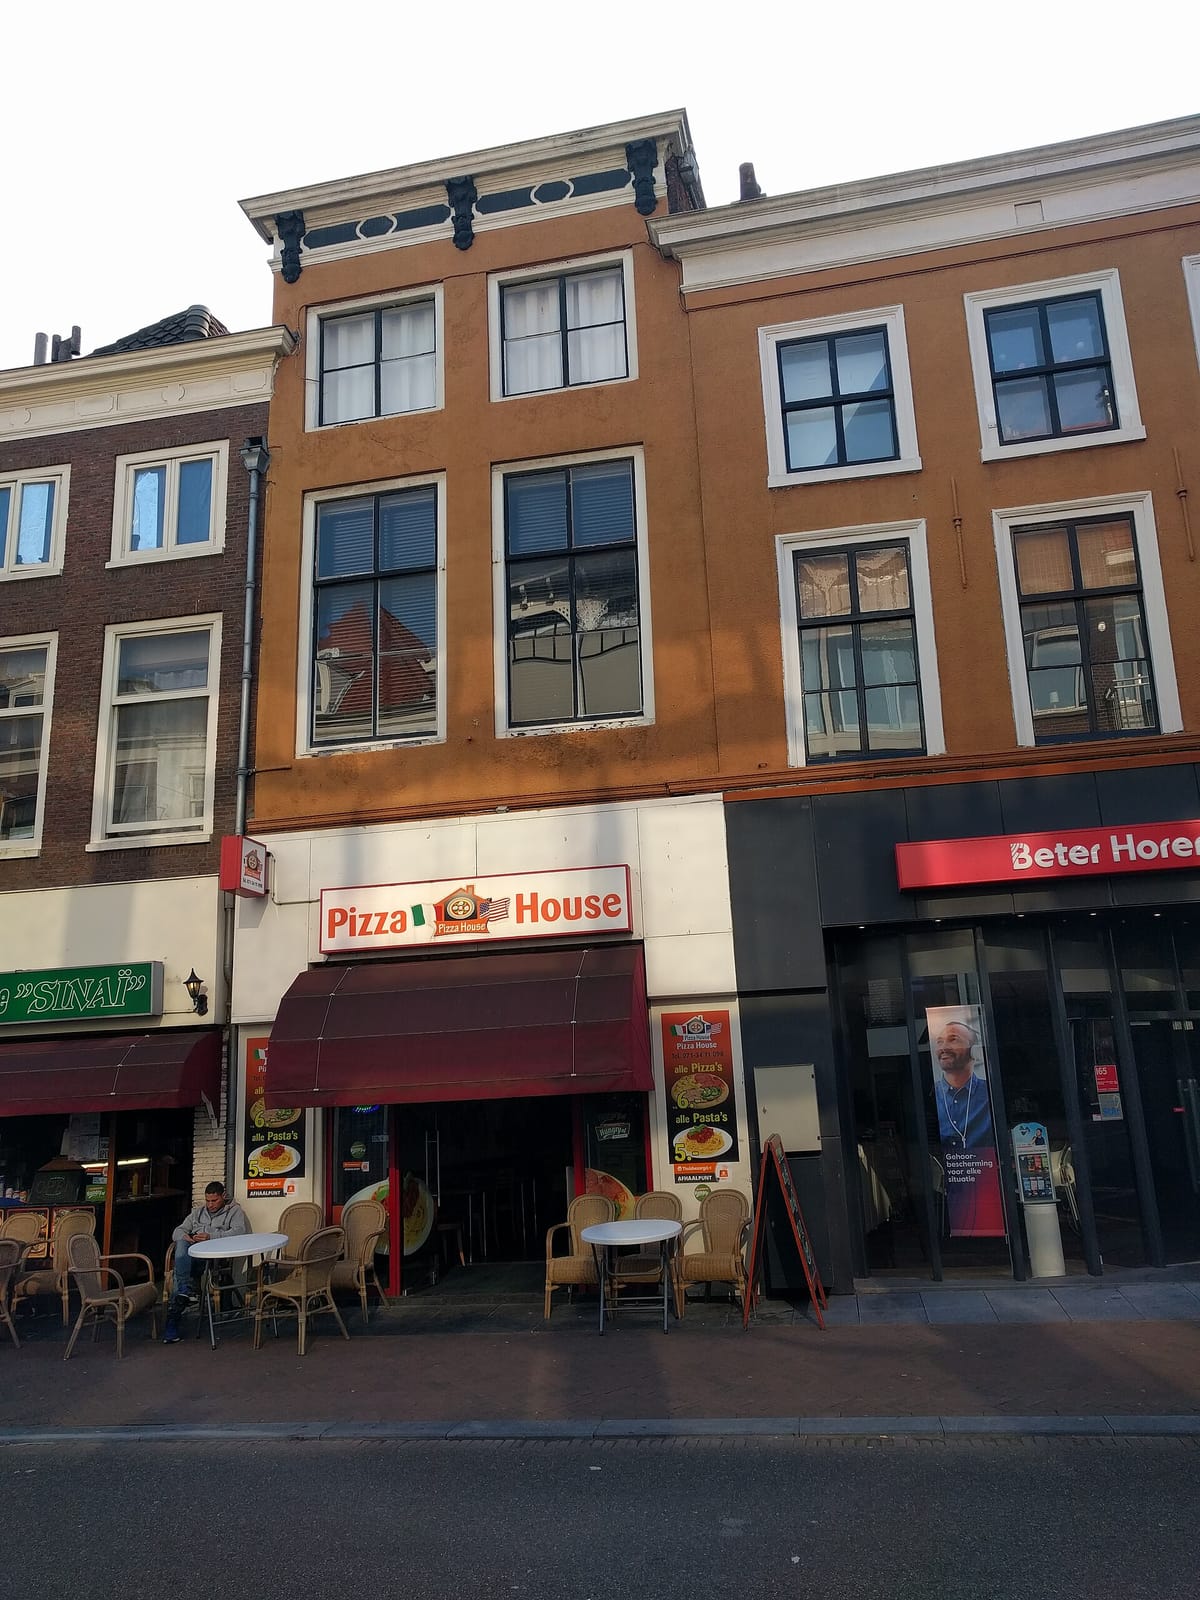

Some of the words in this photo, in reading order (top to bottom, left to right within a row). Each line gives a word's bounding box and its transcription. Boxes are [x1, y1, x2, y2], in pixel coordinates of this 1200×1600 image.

[1010, 842, 1100, 870] Beter
[327, 906, 407, 939] Pizza
[515, 892, 622, 924] House
[438, 922, 459, 933] Pizza
[460, 922, 486, 932] House
[676, 1042, 695, 1050] Pizza
[695, 1041, 718, 1049] House
[674, 1065, 689, 1074] alle
[691, 1062, 723, 1073] Pizza's
[675, 1114, 690, 1124] alle
[692, 1112, 728, 1123] Pasta's
[251, 1133, 265, 1142] alle
[267, 1130, 298, 1141] Pasta's
[946, 1160, 993, 1169] bescherming
